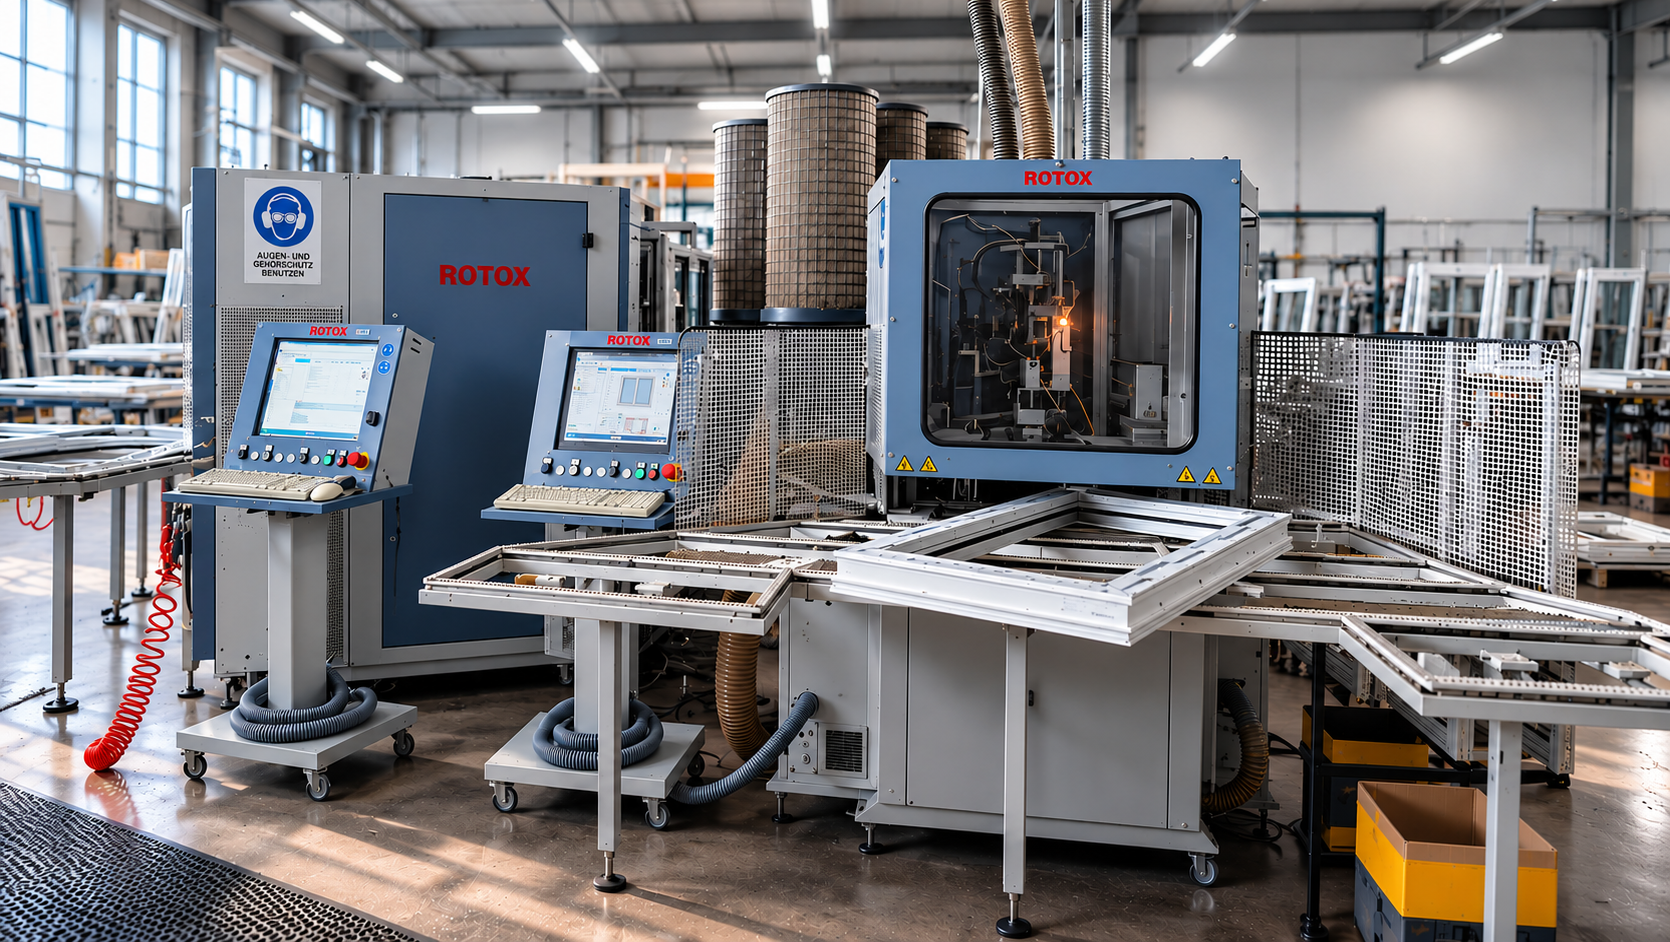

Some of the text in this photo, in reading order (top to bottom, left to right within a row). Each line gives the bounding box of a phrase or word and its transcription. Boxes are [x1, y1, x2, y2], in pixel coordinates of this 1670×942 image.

[1024, 170, 1093, 186] ROTOX
[257, 251, 310, 260] AUGEN- UND
[261, 269, 305, 277] BENUTZEN
[439, 264, 531, 287] ROTOX
[309, 325, 348, 337] ROTOX
[606, 334, 651, 346] ROTOX
